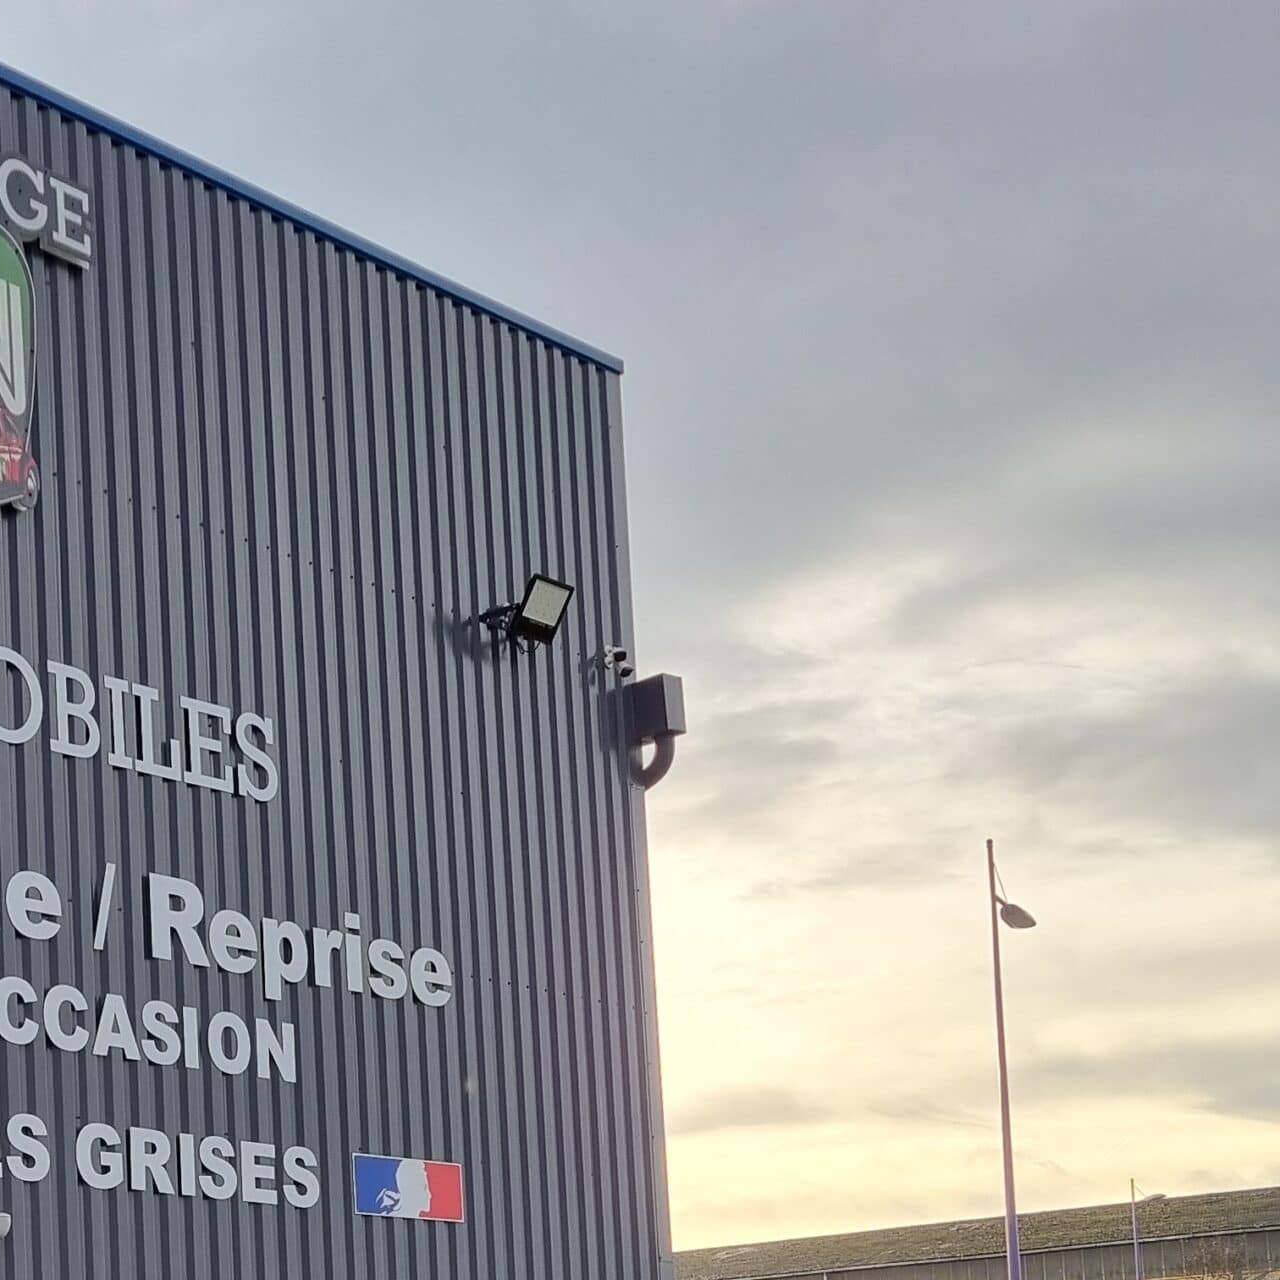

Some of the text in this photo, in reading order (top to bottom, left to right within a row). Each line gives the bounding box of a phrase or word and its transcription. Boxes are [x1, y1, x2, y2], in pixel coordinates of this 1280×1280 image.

[93, 863, 115, 950] /
[149, 873, 452, 1008] Reprise
[76, 1122, 320, 1208] GRISES
